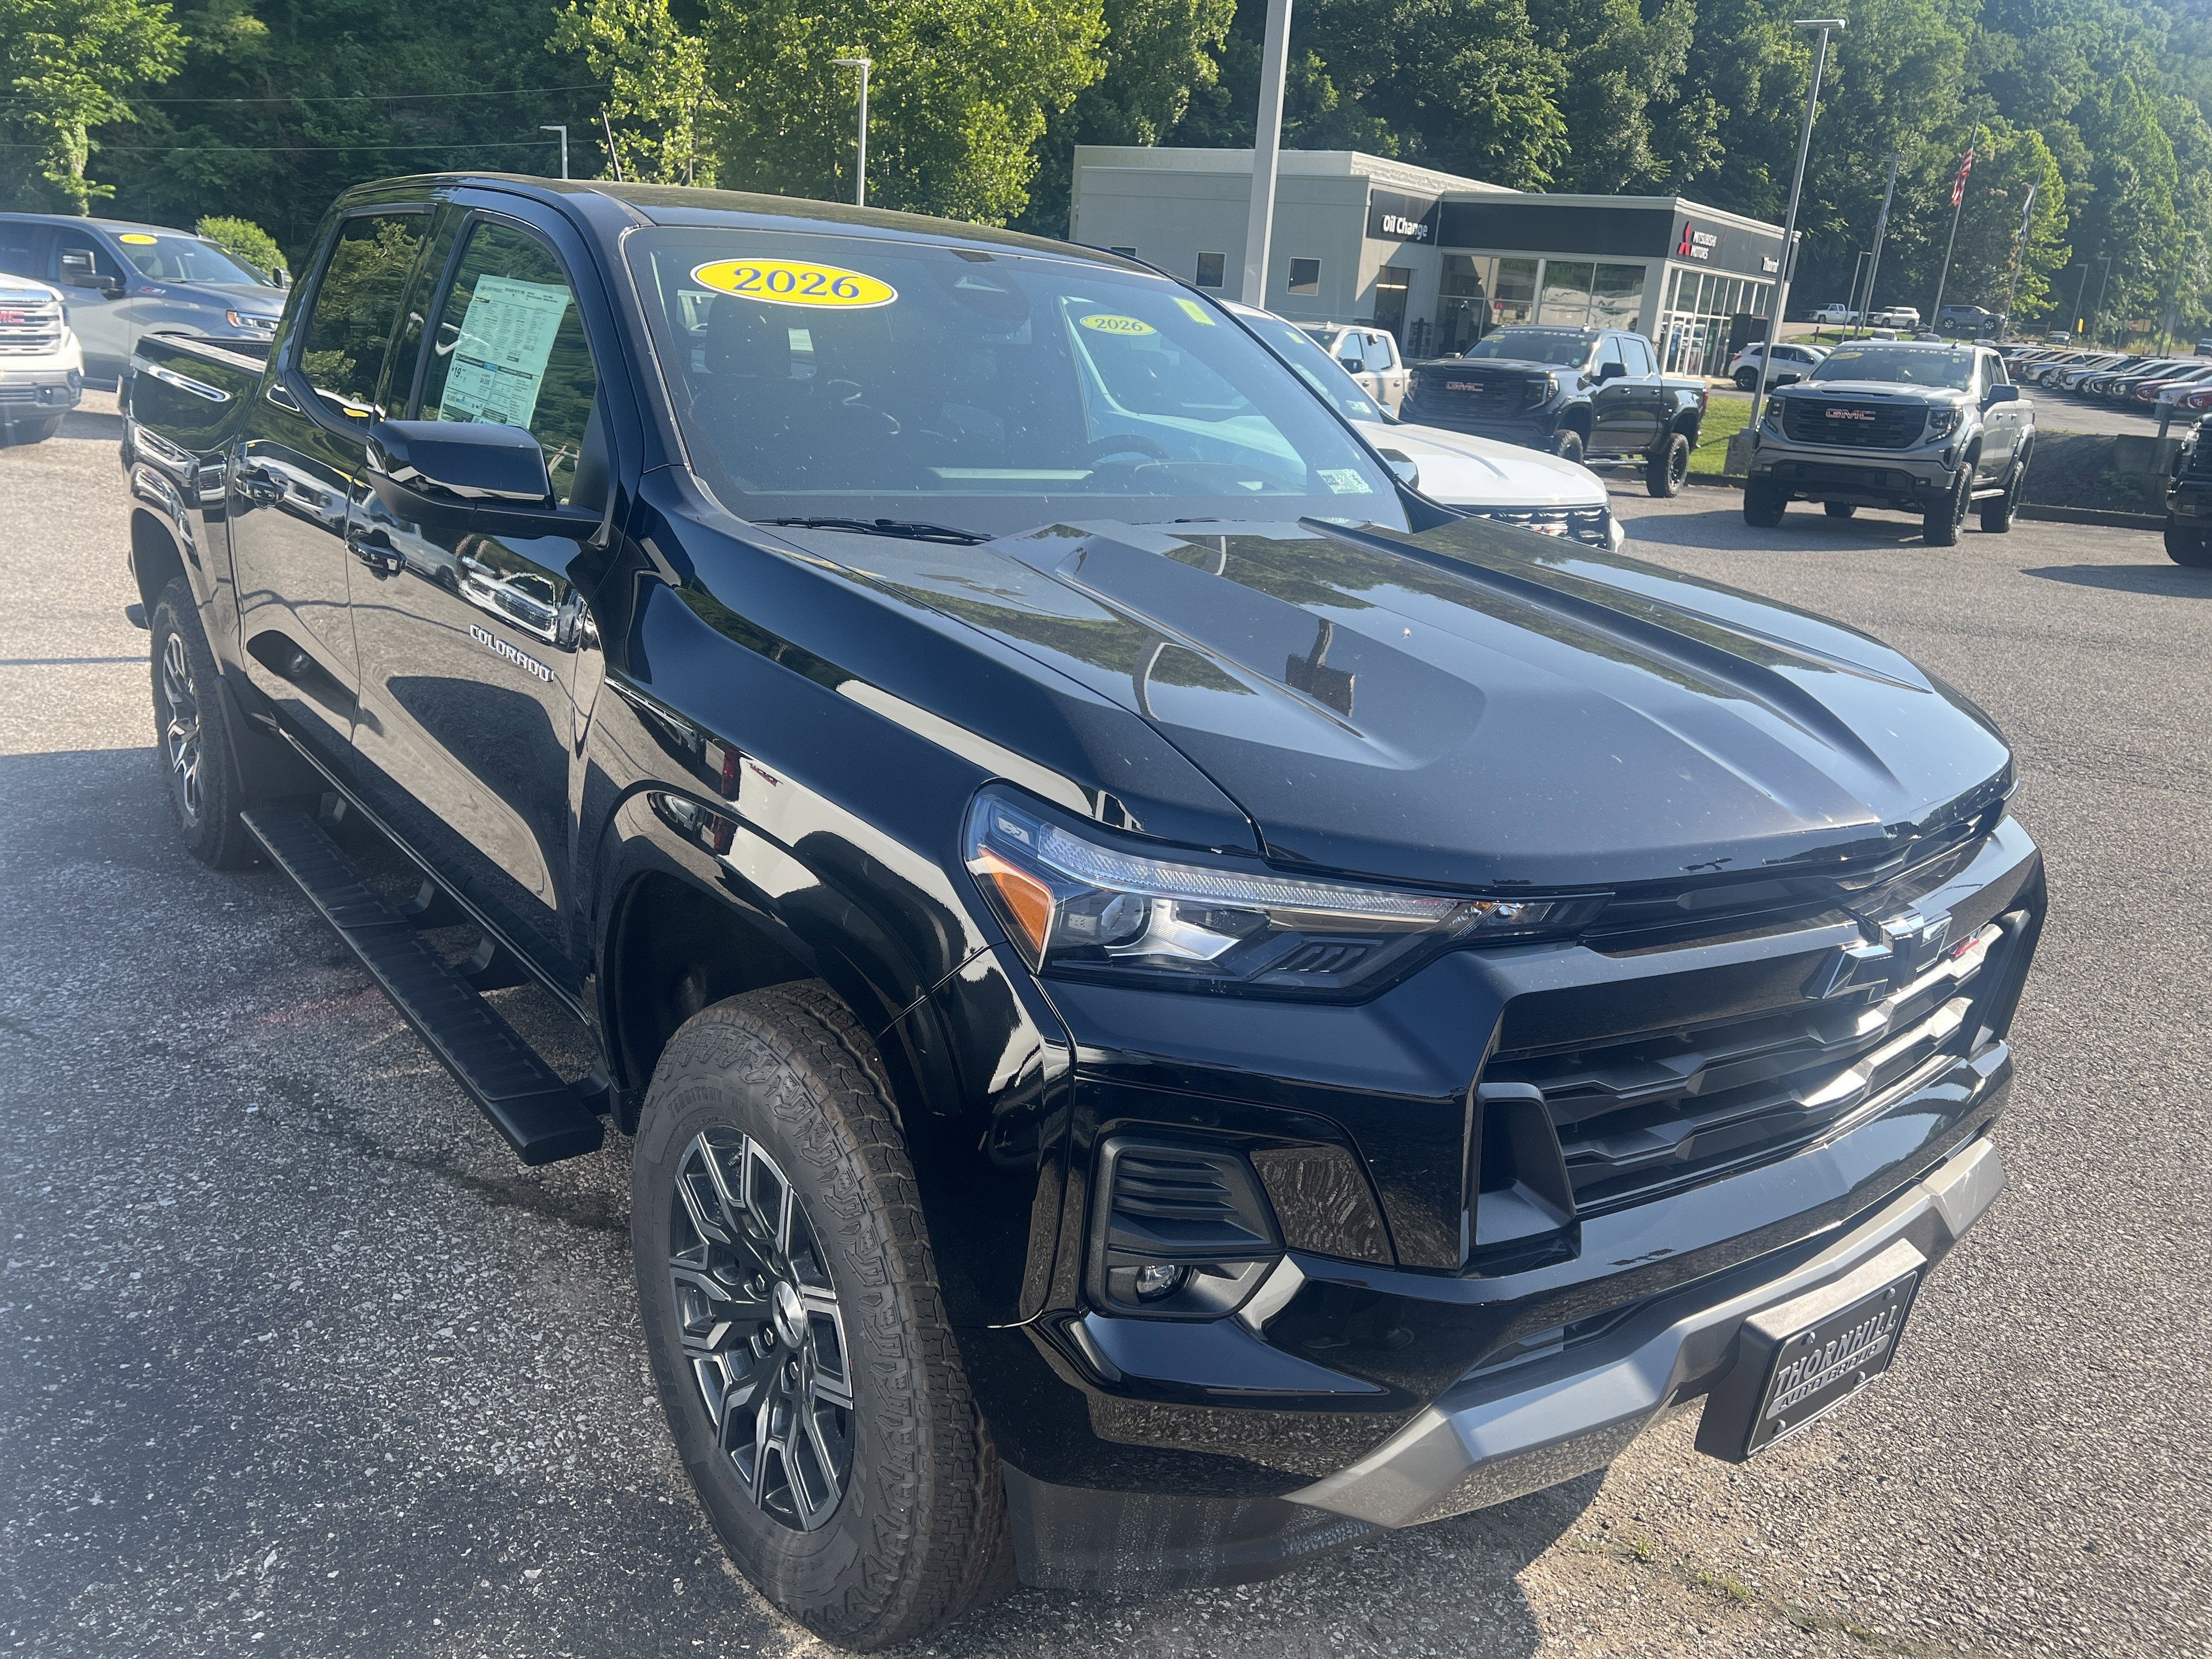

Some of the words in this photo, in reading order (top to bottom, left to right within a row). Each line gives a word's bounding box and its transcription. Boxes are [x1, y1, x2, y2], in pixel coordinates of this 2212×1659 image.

[1383, 215, 1396, 233] Oil
[1396, 217, 1428, 240] Change
[732, 268, 860, 298] 2026
[1095, 318, 1143, 331] 2026
[1446, 381, 1484, 392] GMC
[1825, 408, 1876, 421] GMC
[470, 624, 552, 682] COLORADO
[668, 1086, 722, 1118] TERRITORY
[1773, 1305, 1897, 1399] THORNHILL
[1778, 1378, 1822, 1410] AUTO
[1827, 1343, 1877, 1381] GROUP
